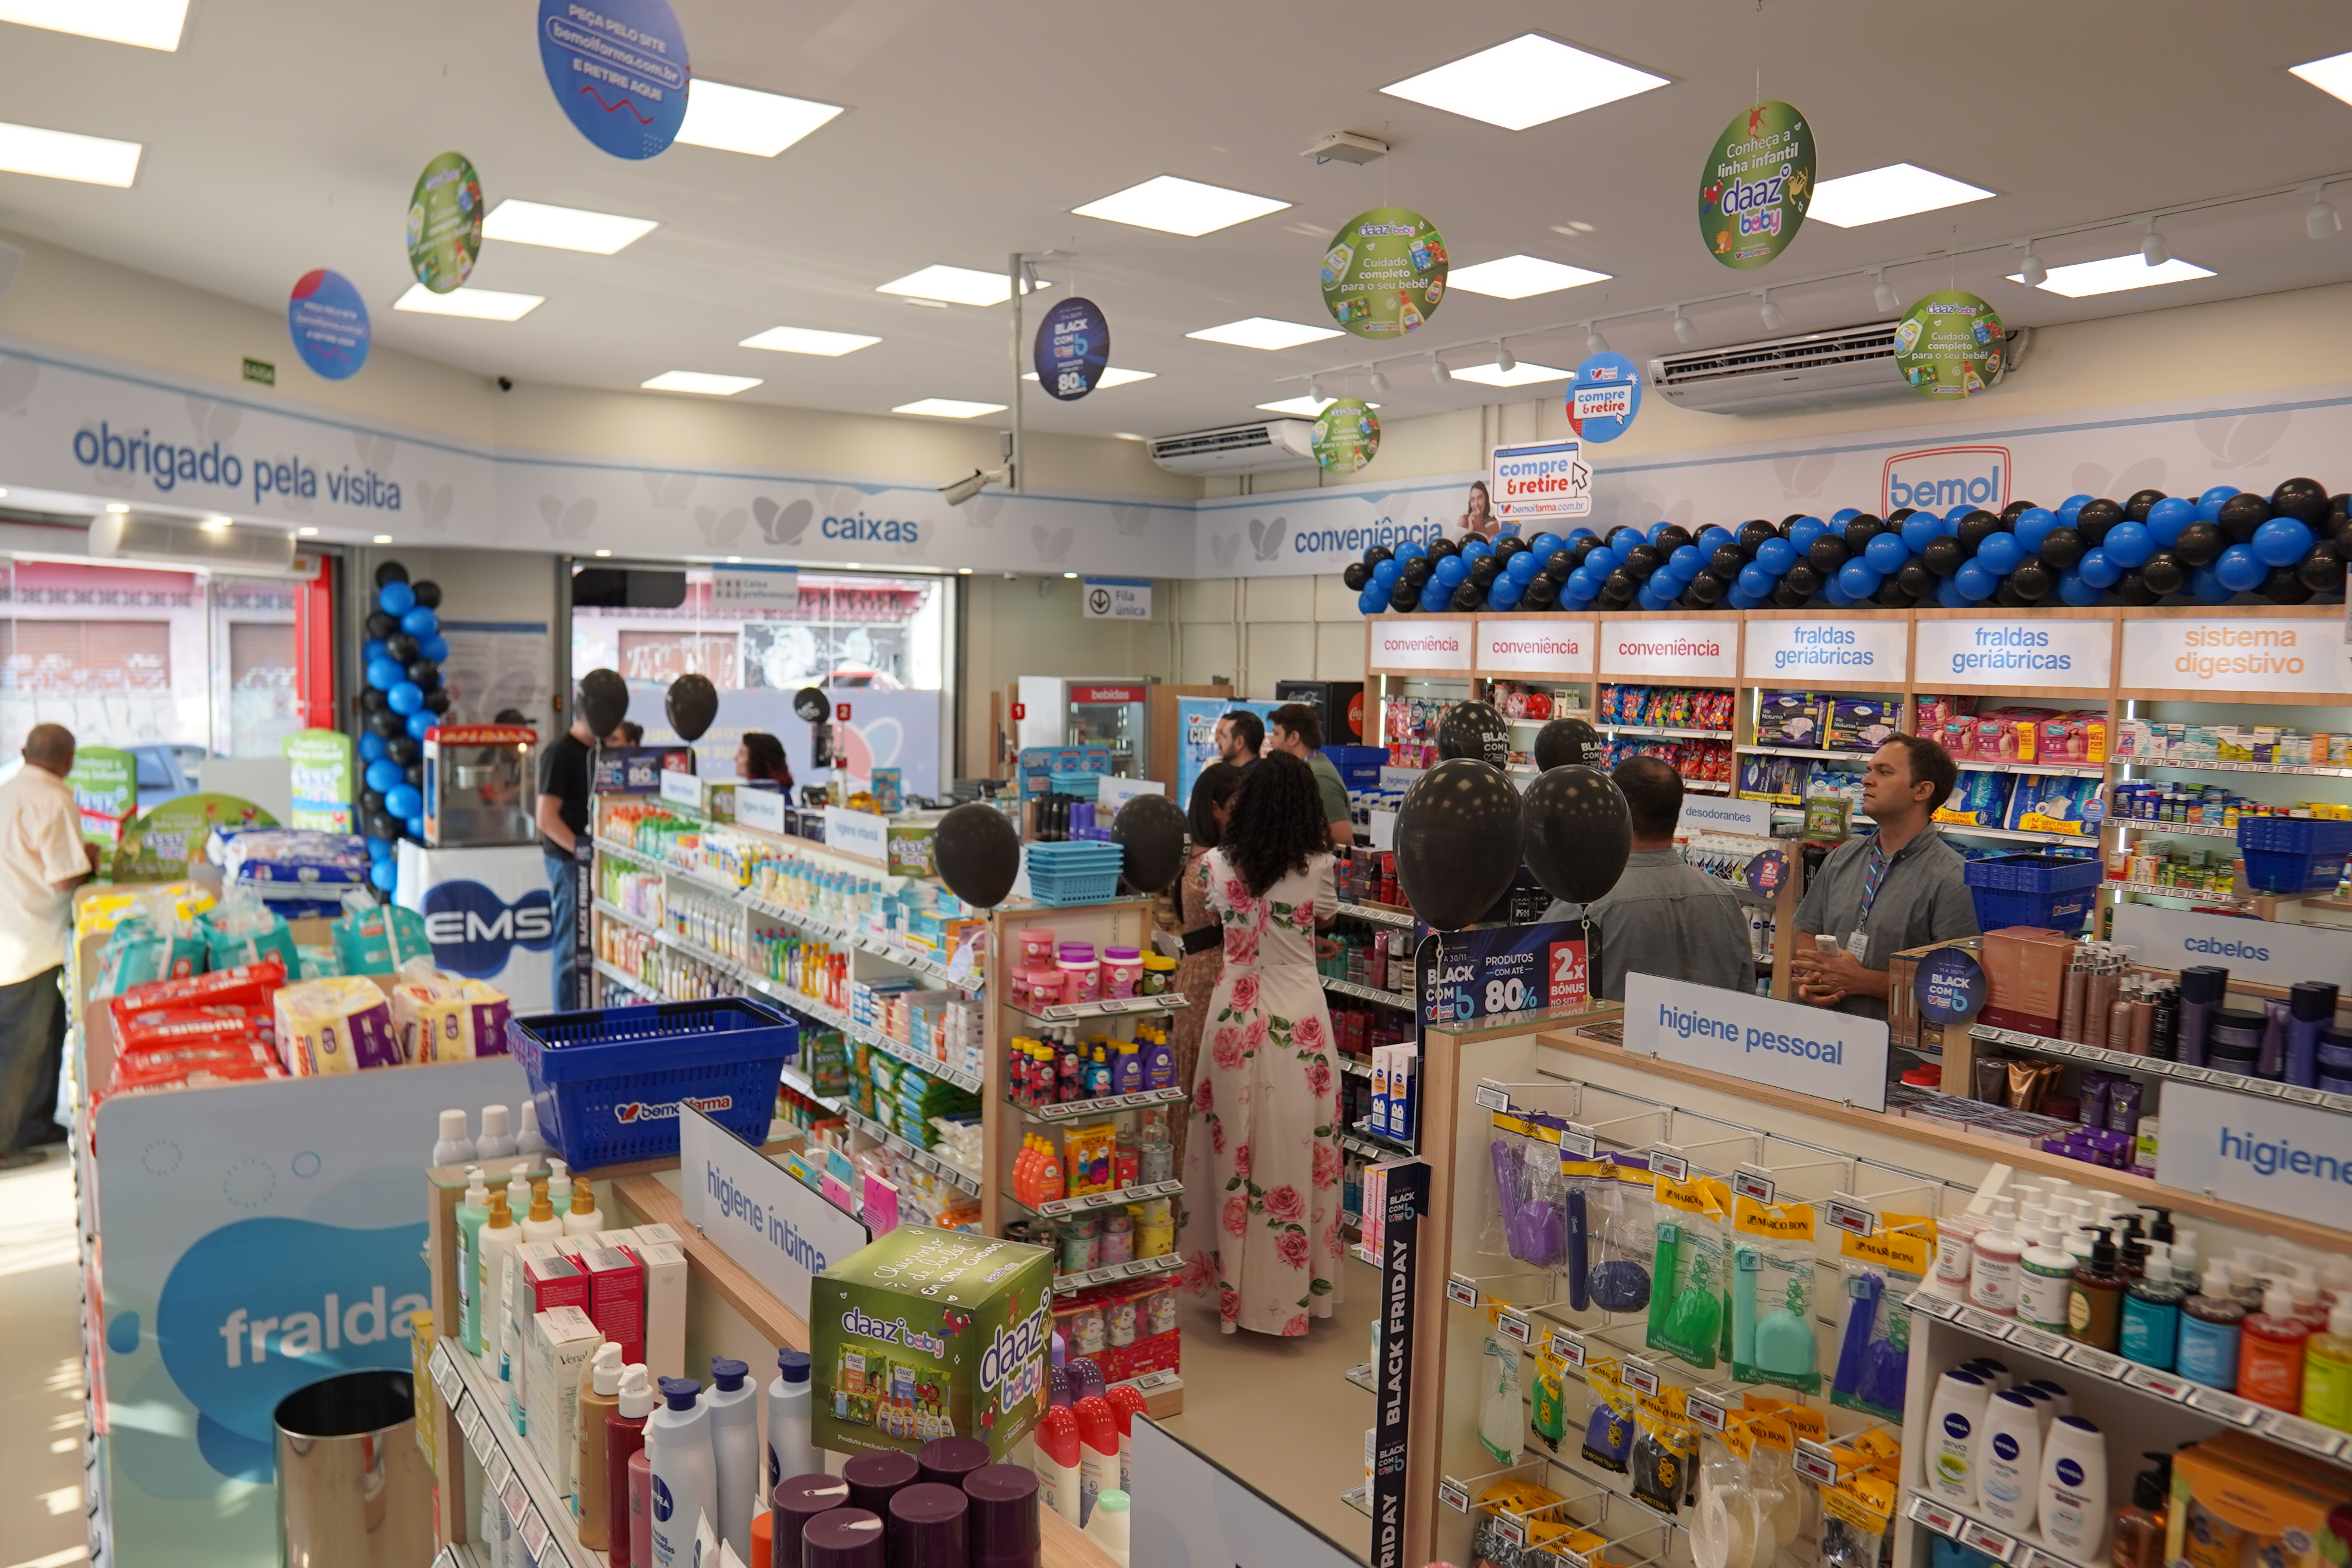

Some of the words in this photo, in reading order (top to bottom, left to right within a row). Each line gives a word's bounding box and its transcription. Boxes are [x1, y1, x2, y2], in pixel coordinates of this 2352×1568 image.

[569, 4, 605, 28] PEÇA
[605, 19, 638, 41] PELO
[638, 33, 667, 53] SITE
[573, 58, 583, 71] E
[583, 62, 629, 89] RETIRE
[630, 79, 663, 102] AQUI
[1726, 134, 1780, 158] Conheça
[1784, 130, 1791, 142] a
[1718, 161, 1748, 177] linha
[1752, 142, 1799, 169] infantil
[1723, 179, 1782, 215] daaz
[1359, 222, 1390, 237] daaz
[1393, 225, 1415, 237] baby
[1741, 208, 1781, 235] baby
[1363, 258, 1407, 268] Cuidado
[1359, 269, 1410, 280] completo
[1341, 284, 1364, 293] para
[1399, 278, 1429, 289] bebê!
[1927, 303, 1955, 314] daaz
[1957, 306, 1976, 316] baby
[1055, 318, 1088, 335] BLACK
[1054, 333, 1074, 346] COM
[1931, 332, 1970, 341] Cuidado
[1928, 342, 1973, 351] completo
[1912, 353, 1933, 361] para
[1058, 372, 1088, 391] 80%
[1578, 391, 1625, 403] compre
[1591, 400, 1625, 413] retire
[73, 422, 243, 492] obrigado
[254, 456, 318, 504] pela
[326, 465, 402, 511] visita
[1500, 460, 1568, 476] compre
[1519, 474, 1568, 494] retire
[1891, 466, 1999, 508] bemol
[1512, 502, 1584, 513] bemolfarma.com.br
[821, 512, 918, 544] caixas
[1295, 516, 1443, 553] conveniência
[1115, 590, 1134, 601] Fila
[1115, 605, 1146, 616] única
[1385, 634, 1459, 652] conveniência
[1794, 624, 1856, 646] fraldas
[1974, 625, 2050, 648] fraldas
[2184, 626, 2298, 648] sistema
[1492, 636, 1579, 656] conveniência
[1618, 636, 1720, 658] conveniência
[1774, 645, 1875, 669] geriátricas
[1951, 647, 2072, 674] geriátricas
[2175, 650, 2305, 680] digestivo
[1091, 689, 1130, 700] bebidas
[840, 705, 847, 717] 2
[1484, 743, 1504, 752] COM
[1387, 776, 1410, 786] higiene
[1685, 807, 1751, 823] desodorantes
[1764, 862, 1777, 875] 2x
[426, 906, 553, 945] EMS
[2184, 936, 2270, 961] cabelos
[1486, 953, 1533, 966] PRODUTOS
[1554, 948, 1585, 982] 2x
[1428, 965, 1475, 985] BLACK
[1494, 968, 1508, 976] COM
[1509, 966, 1524, 975] ATÉ
[1551, 982, 1585, 996] BÔNUS
[1931, 973, 1971, 990] BLACK
[1426, 987, 1454, 1002] COM
[1485, 978, 1538, 1013] 80%
[1929, 985, 1953, 996] COM
[1659, 1003, 1739, 1042] higiene
[1746, 1027, 1843, 1065] pessoal
[2219, 1127, 2352, 1185] higiene
[1390, 1192, 1415, 1205] BLACK
[1389, 1203, 1404, 1213] COM
[706, 1160, 763, 1235] higiene
[767, 1206, 826, 1275] íntima
[1757, 1216, 1787, 1229] MARCO
[1789, 1219, 1808, 1231] BONI
[874, 1237, 945, 1278] Cheirinho
[907, 1266, 934, 1281] de
[926, 1243, 976, 1270] bebê
[1891, 1250, 1915, 1265] BONI
[921, 1282, 941, 1296] EM
[945, 1267, 968, 1283] CADA
[1389, 1240, 1408, 1334] FRIDAY
[219, 1285, 433, 1369] fralda
[843, 1306, 898, 1343] daaz
[903, 1328, 944, 1359] baby
[982, 1310, 1042, 1389] daaz
[847, 1354, 865, 1364] daaz
[847, 1371, 862, 1381] Short
[896, 1367, 914, 1376] daaz
[1003, 1356, 1042, 1412] baby
[1385, 1337, 1404, 1427] BLACK
[1945, 1420, 1969, 1432] NIVEA
[838, 1434, 861, 1446] Produto
[1994, 1440, 2017, 1453] NIVEA
[1380, 1443, 1405, 1459] BLACK
[1378, 1457, 1394, 1467] COM
[2057, 1465, 2082, 1480] NIVEA
[652, 1490, 669, 1509] NIVEA
